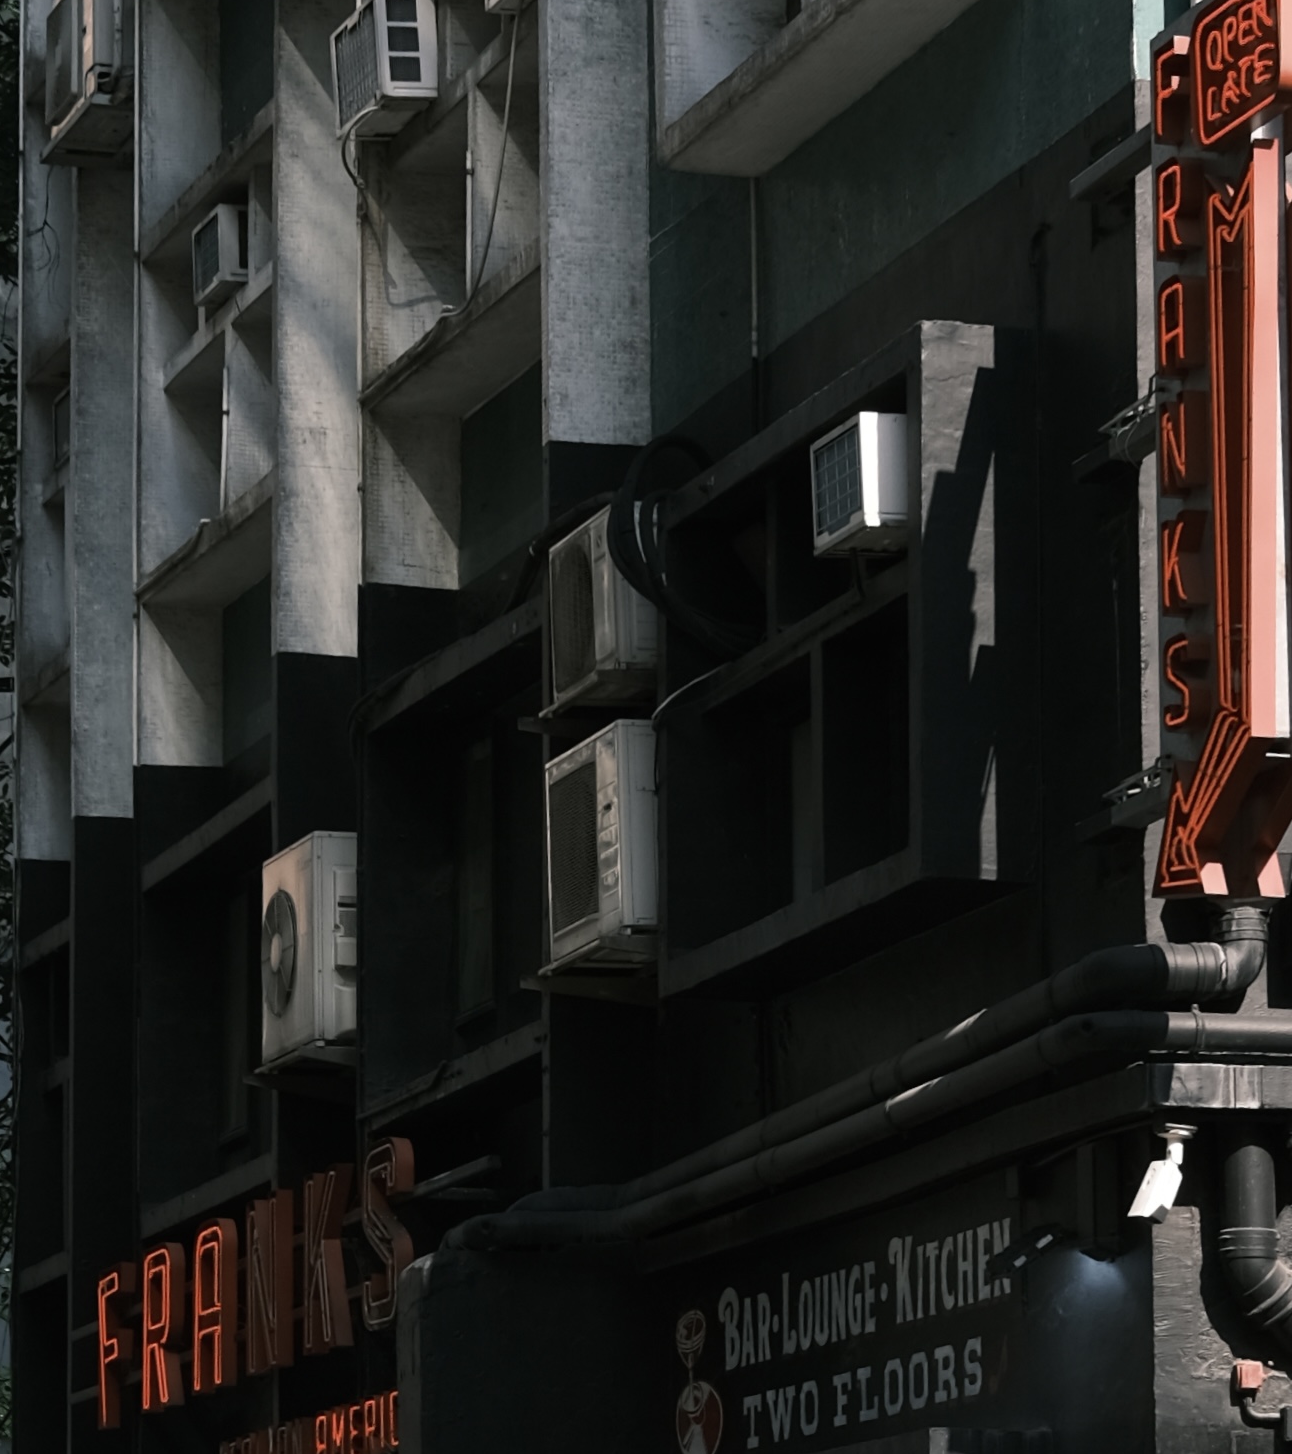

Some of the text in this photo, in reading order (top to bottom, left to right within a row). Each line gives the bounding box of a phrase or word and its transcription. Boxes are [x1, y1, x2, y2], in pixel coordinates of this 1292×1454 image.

[1206, 51, 1277, 125] LATE
[97, 1135, 414, 1429] FRANKS
[742, 1336, 984, 1450] TWO FLOORS
